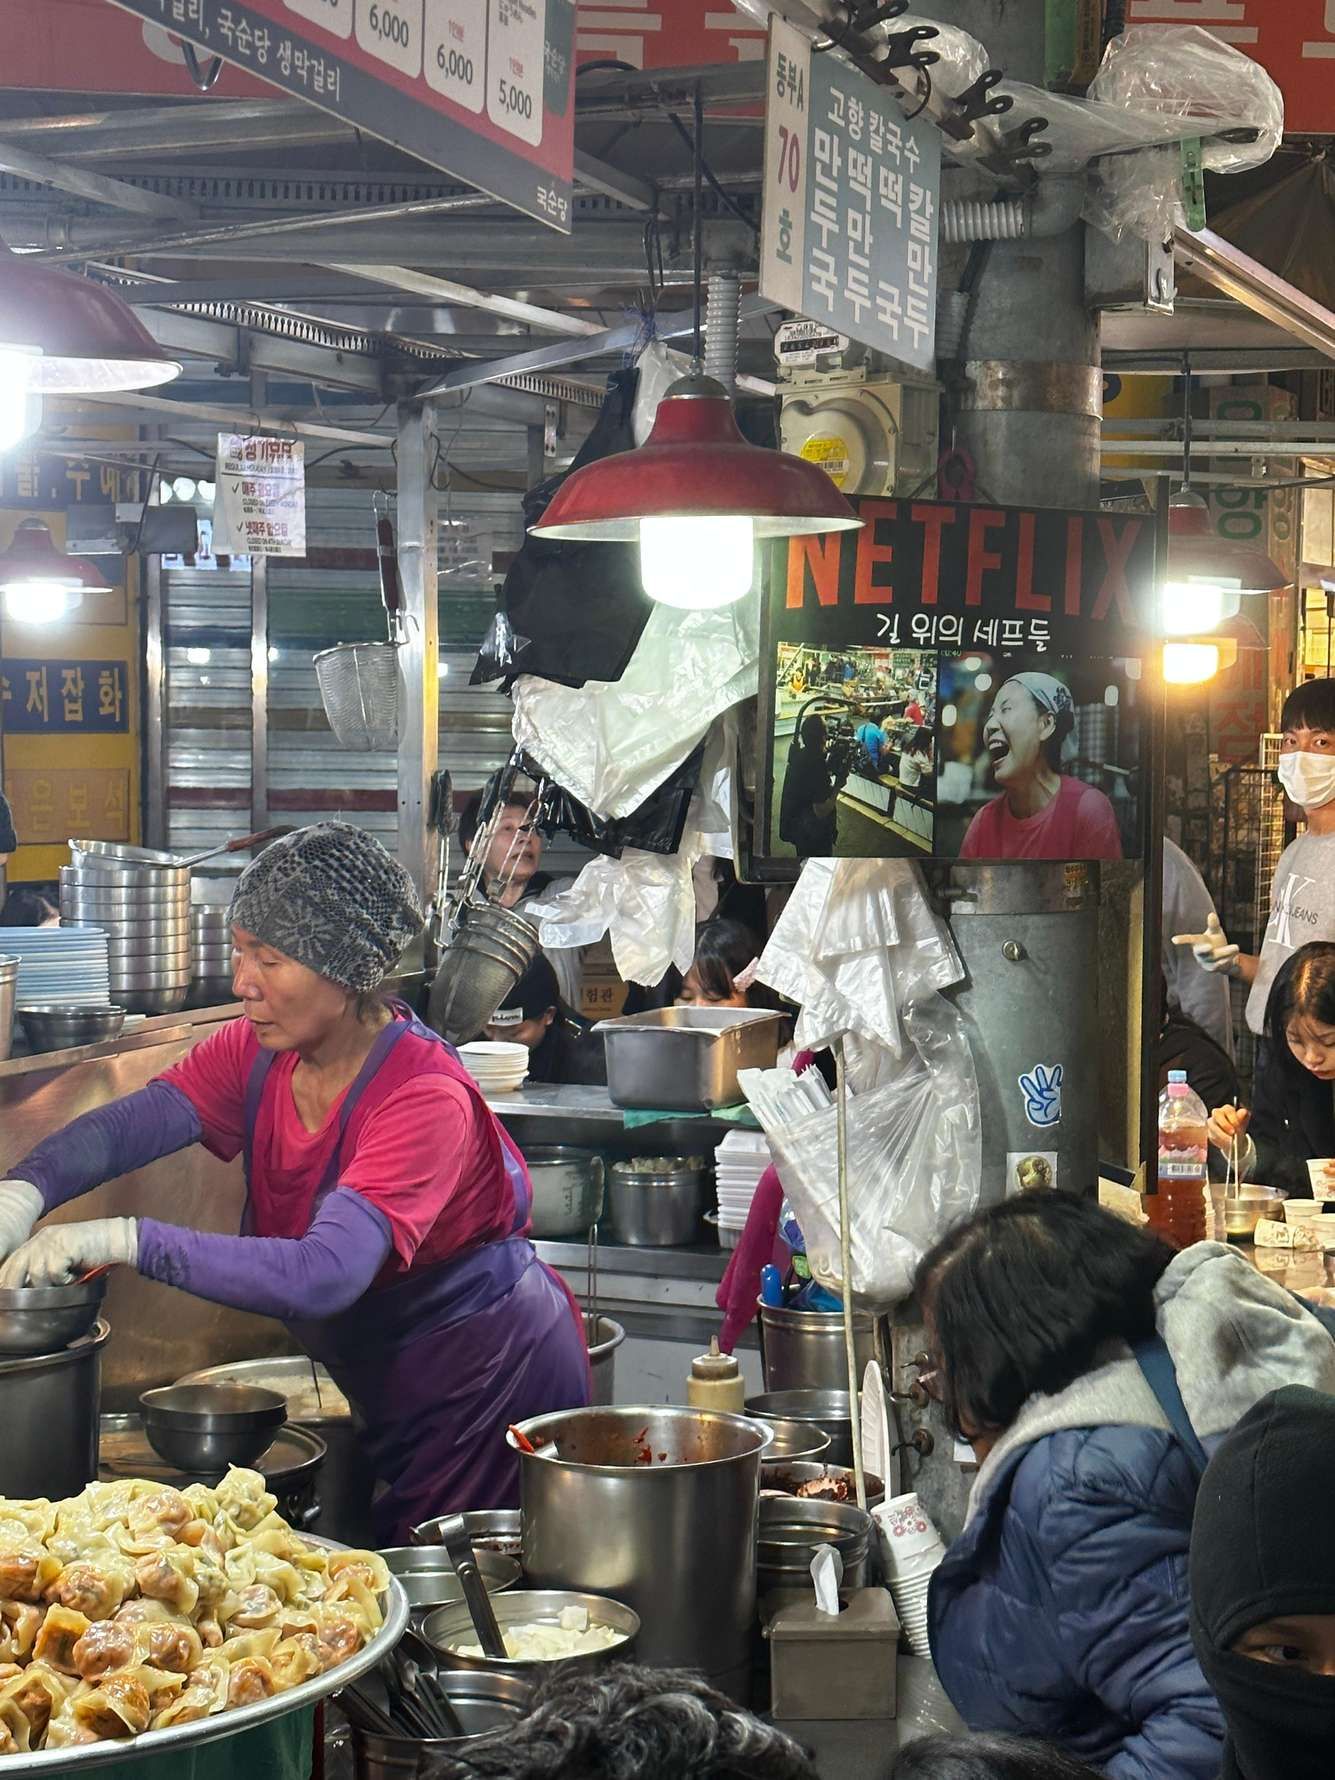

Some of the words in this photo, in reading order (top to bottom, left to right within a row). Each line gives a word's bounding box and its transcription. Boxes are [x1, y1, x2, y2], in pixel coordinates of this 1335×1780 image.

[217, 8, 271, 65] 국순당
[276, 40, 341, 102] 생막걸리
[369, 4, 409, 48] 6,000
[437, 44, 473, 85] 6,000
[499, 79, 532, 119] 5,000
[778, 126, 800, 193] 70
[537, 186, 568, 222] 국순당
[809, 127, 843, 312] 만두국
[776, 207, 793, 265] 호
[844, 147, 873, 324] 떡만두
[903, 182, 934, 349] 칼만두
[785, 500, 1143, 627] NETFLIX
[876, 613, 900, 644] 길
[911, 613, 963, 646] 위의
[973, 618, 1051, 652] 세프들
